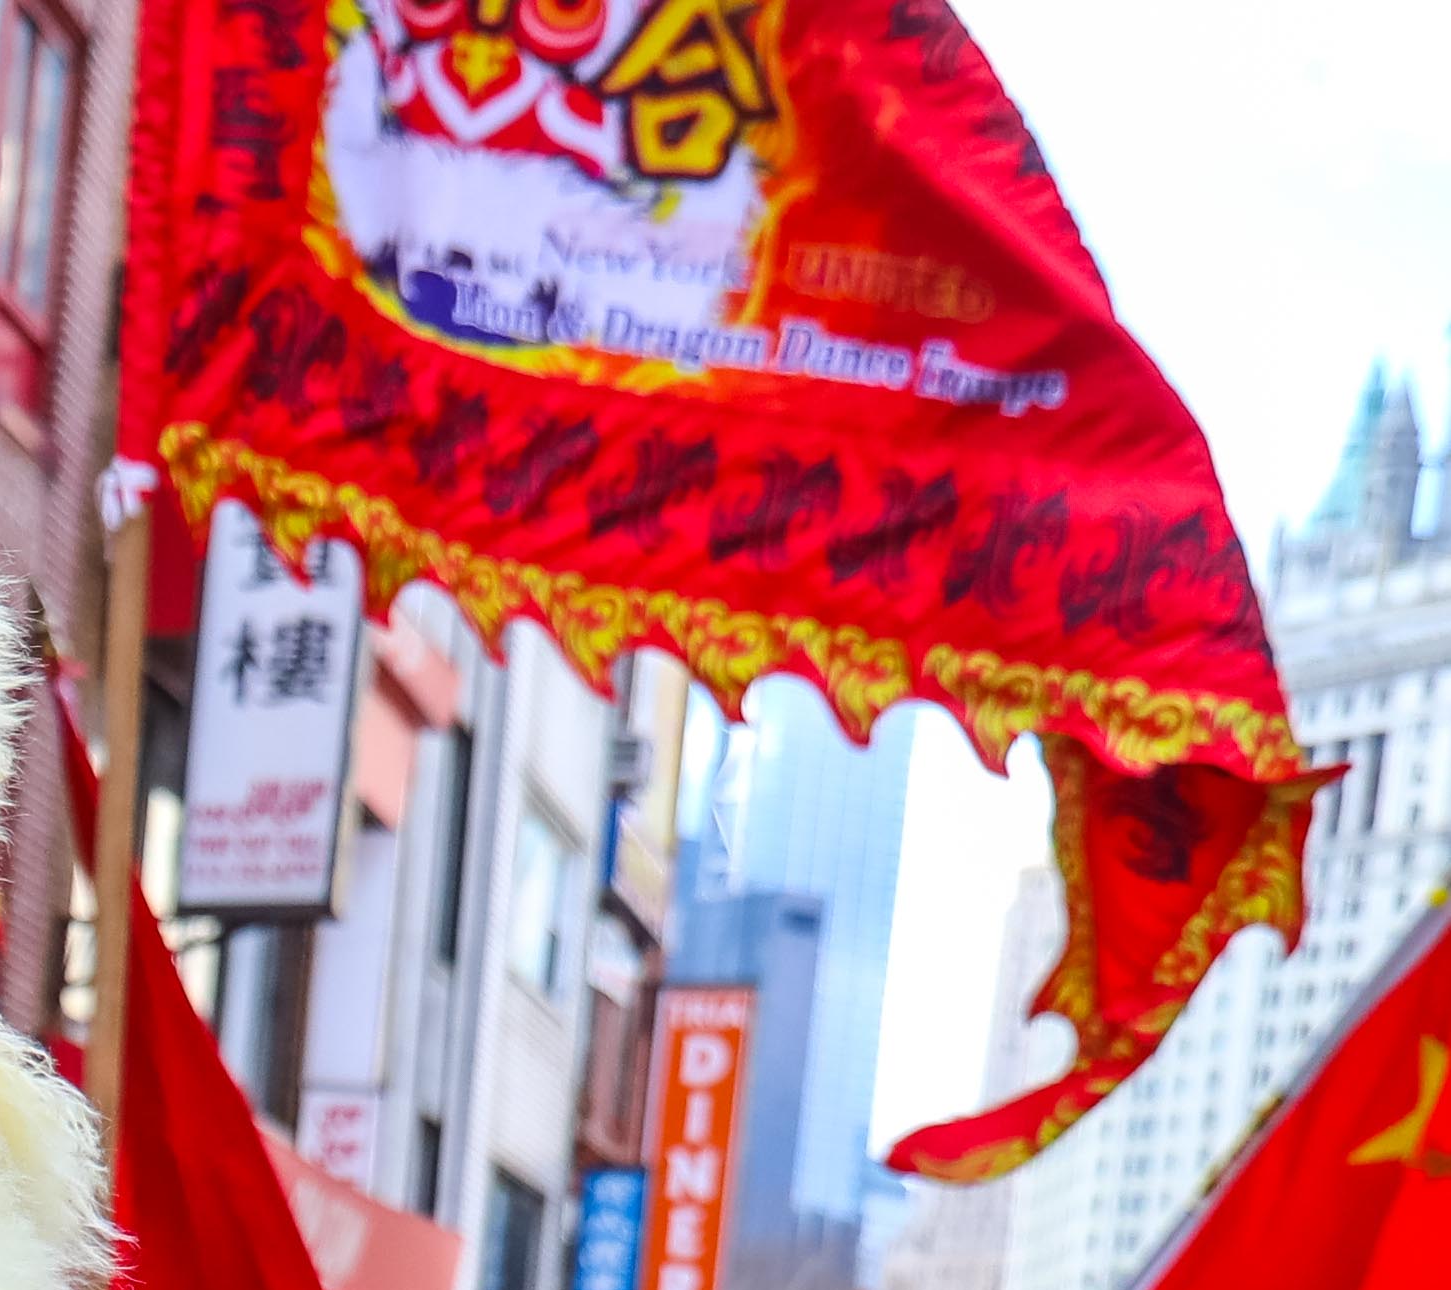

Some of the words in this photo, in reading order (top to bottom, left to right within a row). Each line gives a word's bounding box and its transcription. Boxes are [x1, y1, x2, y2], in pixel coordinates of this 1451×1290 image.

[540, 227, 638, 275] New
[646, 238, 748, 288] York
[453, 281, 543, 343] Lion
[546, 299, 589, 344] &
[603, 304, 767, 369] Dragon
[778, 320, 911, 389] Dance
[917, 340, 1067, 417] Troupe
